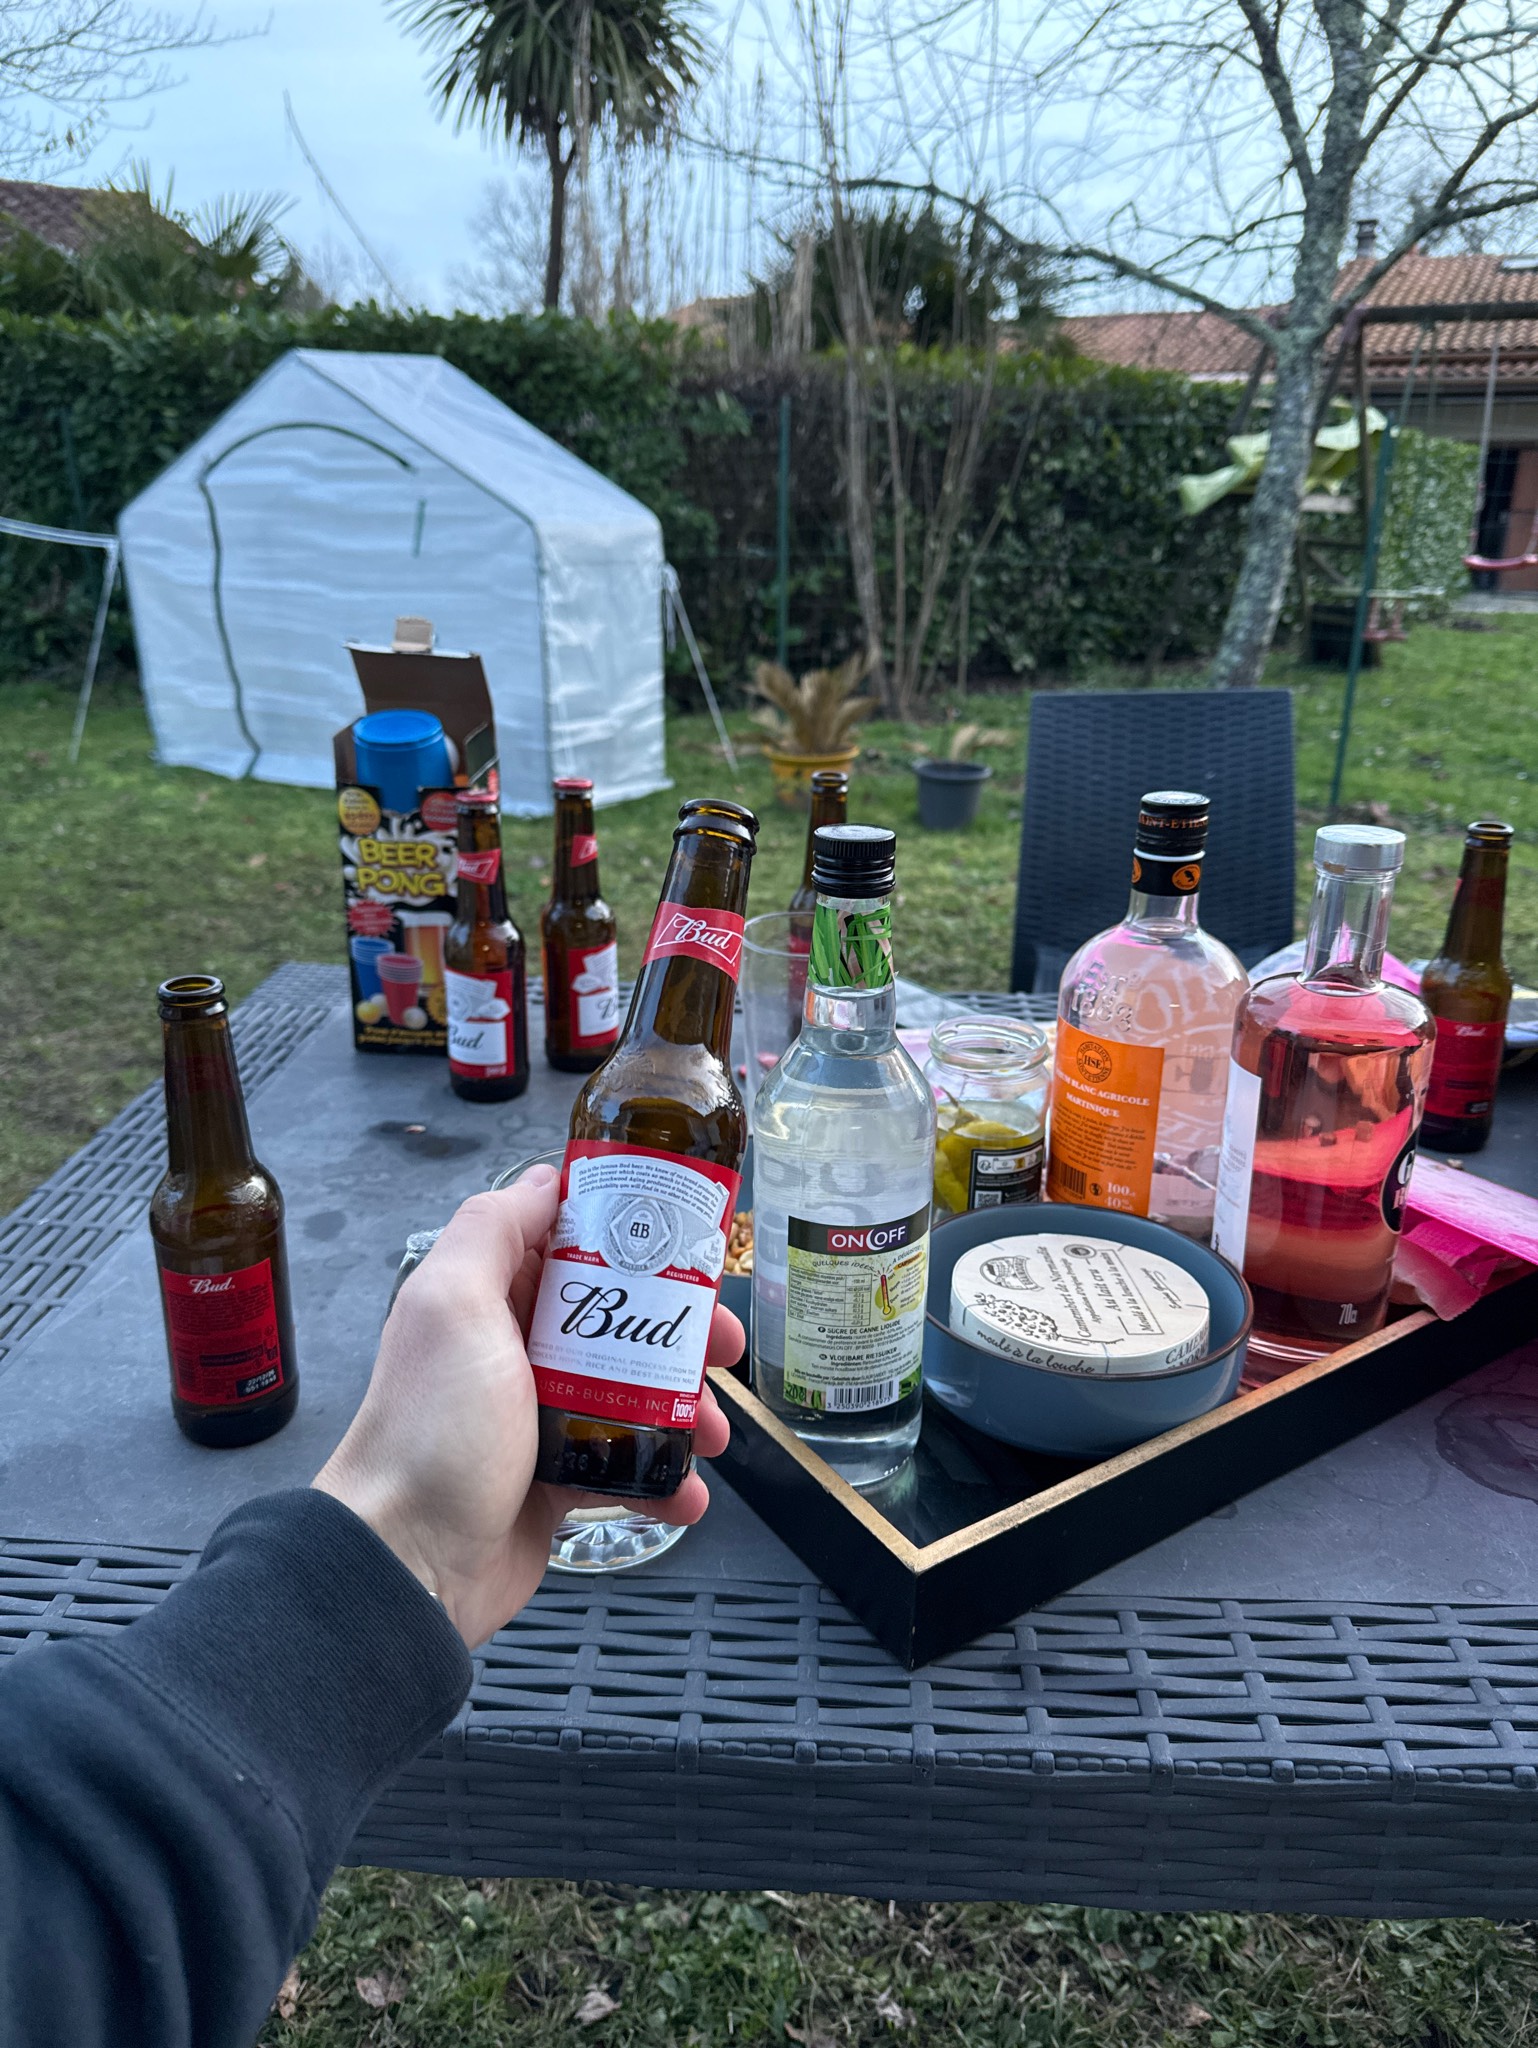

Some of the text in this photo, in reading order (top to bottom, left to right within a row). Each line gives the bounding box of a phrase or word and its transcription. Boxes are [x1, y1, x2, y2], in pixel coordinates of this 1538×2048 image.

[359, 838, 437, 868] BEER
[357, 867, 447, 897] PONG
[673, 919, 733, 950] Bud
[1454, 1024, 1487, 1037] Bud
[1084, 1055, 1101, 1070] HSE
[1071, 1079, 1097, 1096] BLANC
[1097, 1090, 1150, 1106] AGRICOLE
[1066, 1092, 1120, 1118] MARTINIQUE
[599, 1175, 628, 1183] Beechwood
[629, 1176, 645, 1184] Aging
[646, 1179, 671, 1189] produces
[655, 1166, 669, 1174] know
[684, 1175, 698, 1186] brand
[659, 1174, 674, 1183] much
[681, 1182, 693, 1190] brew
[591, 1182, 619, 1192] drinkability
[668, 1191, 681, 1199] other
[629, 1221, 651, 1239] AB
[831, 1233, 864, 1248] ON
[566, 1252, 600, 1263] TRADE MARK
[812, 1260, 850, 1268] QUELQUES
[1036, 1246, 1063, 1282] Normandie
[1101, 1252, 1115, 1266] main
[189, 1277, 233, 1294] Bud
[666, 1270, 700, 1283] REGISTERED
[1088, 1268, 1122, 1312] Au lait cru
[1115, 1277, 1134, 1297] louche
[560, 1281, 692, 1348] Bud
[1060, 1293, 1092, 1338] Camembert
[1131, 1310, 1154, 1332] Moulé
[860, 1326, 879, 1334] CANNE
[880, 1319, 901, 1330] LIQUIDE
[565, 1347, 584, 1356] OUR
[585, 1351, 627, 1365] ORIGINAL
[630, 1359, 667, 1371] PROCESS
[669, 1366, 687, 1375] FROM
[829, 1354, 864, 1362] VLOEIBARE
[866, 1347, 898, 1359] RIETSUIKER
[977, 1329, 1095, 1374] moulé à la louche
[585, 1361, 606, 1371] RICE
[608, 1365, 628, 1374] AND
[630, 1369, 653, 1378] BEST
[654, 1373, 681, 1383] BARLEY
[683, 1377, 695, 1385] MALT
[675, 1403, 694, 1419] 100%
